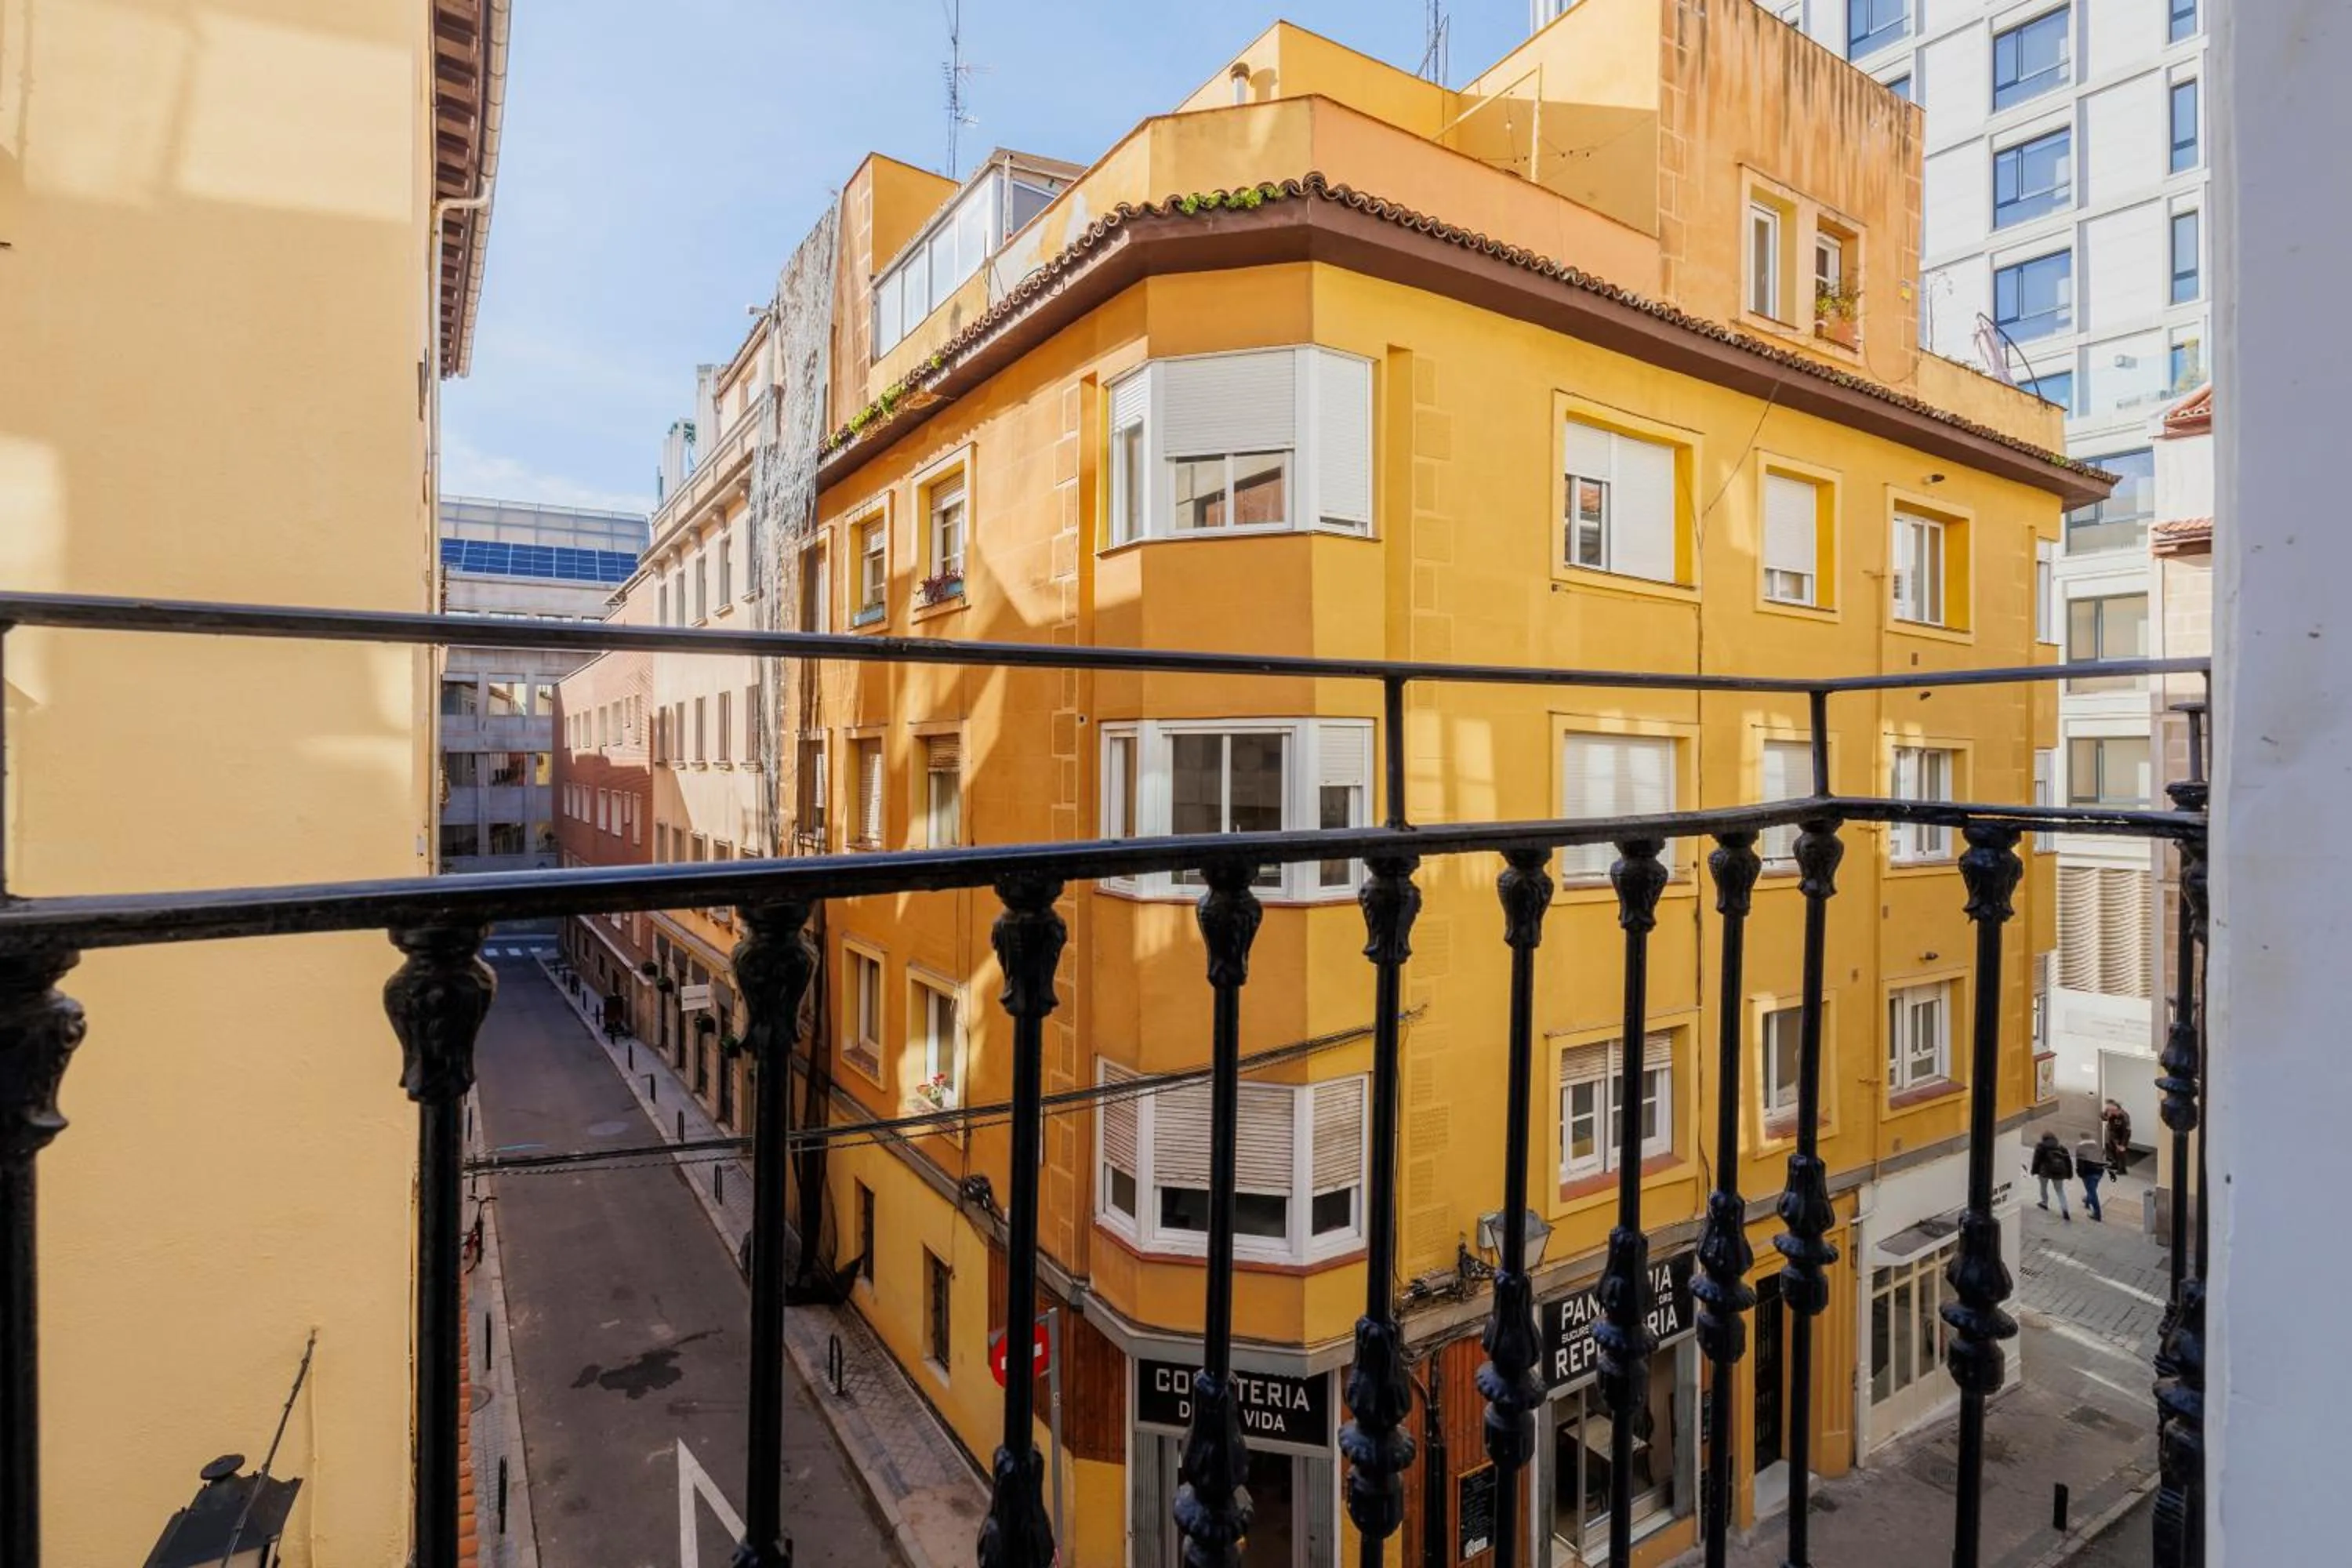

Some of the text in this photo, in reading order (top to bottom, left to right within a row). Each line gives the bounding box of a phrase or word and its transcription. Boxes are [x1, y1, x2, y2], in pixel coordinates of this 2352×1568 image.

[1561, 1265, 1672, 1330] PANIA
[1555, 1305, 1679, 1379] REPRIA
[1156, 1368, 1310, 1411] COTERIA
[1243, 1409, 1286, 1432] VIDA
